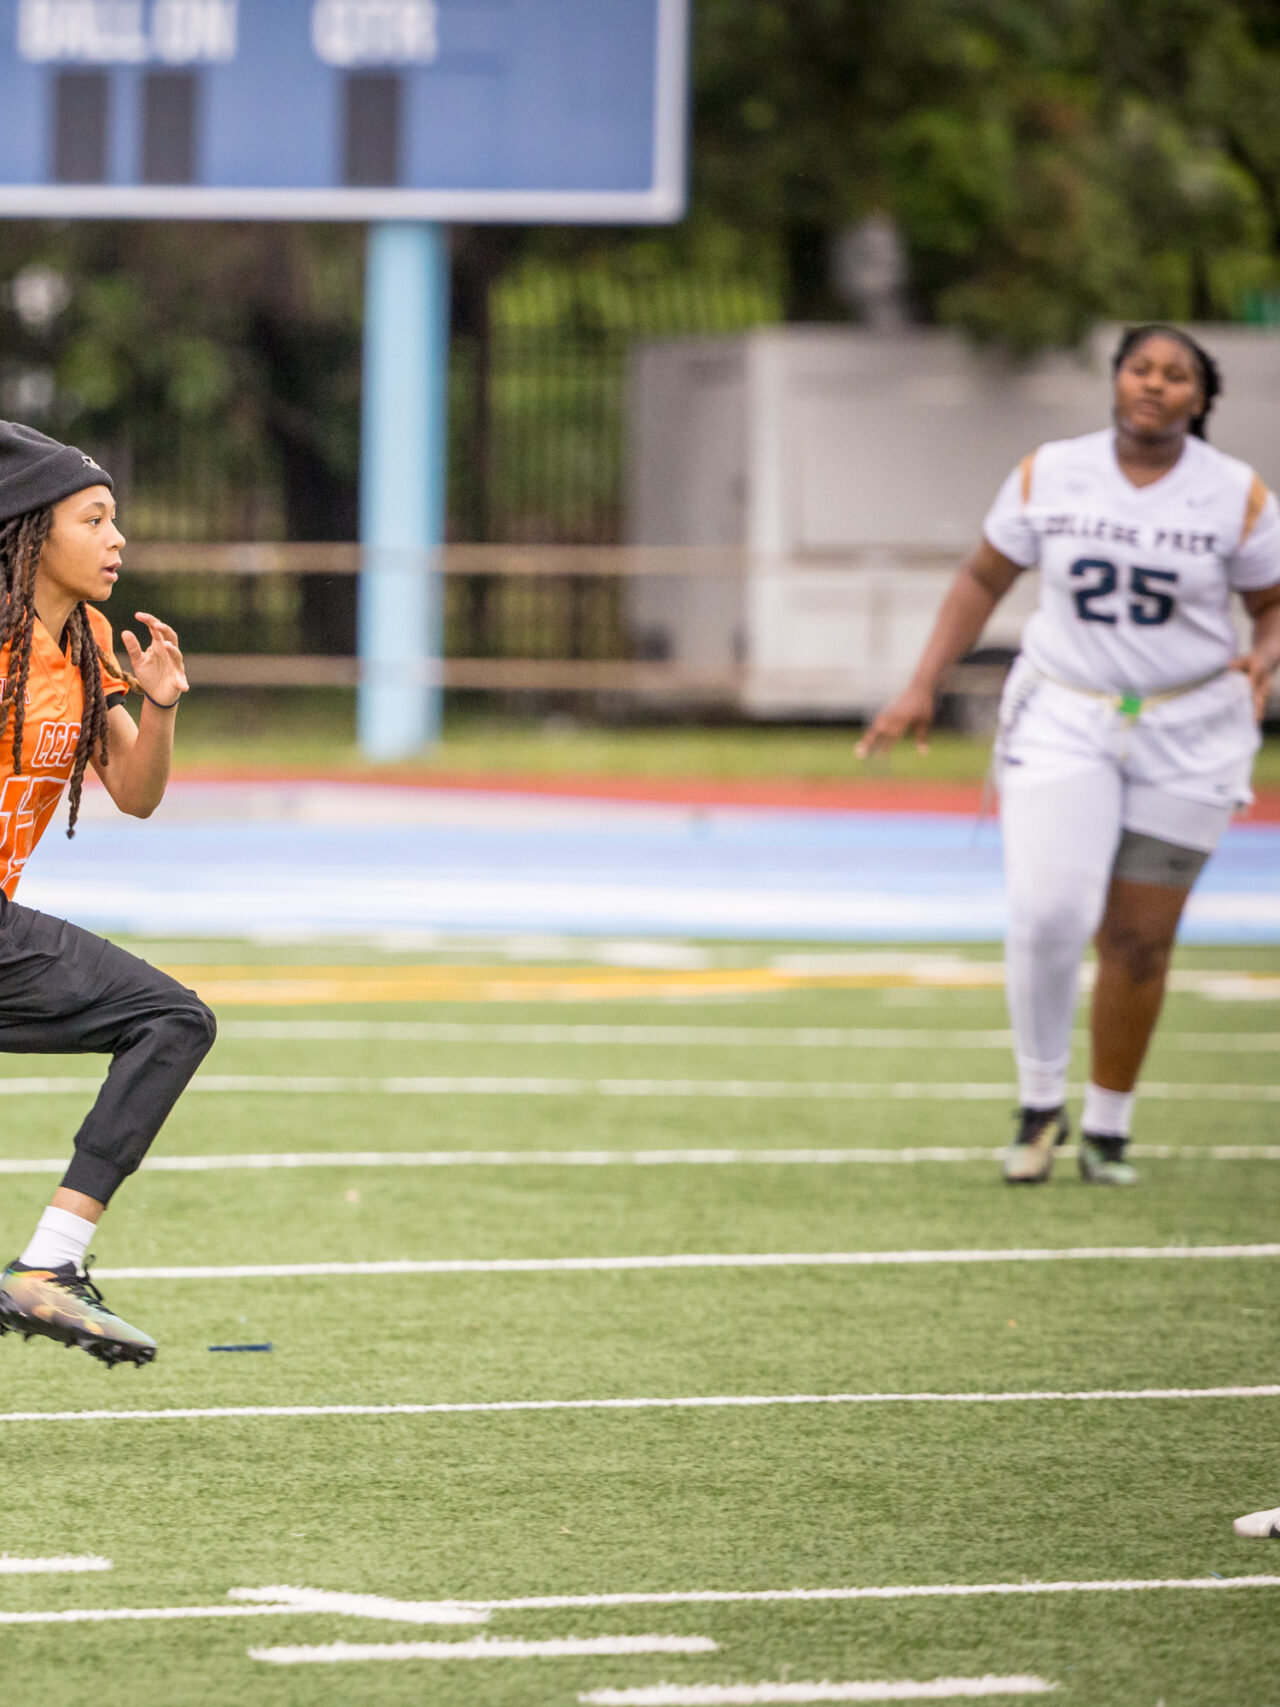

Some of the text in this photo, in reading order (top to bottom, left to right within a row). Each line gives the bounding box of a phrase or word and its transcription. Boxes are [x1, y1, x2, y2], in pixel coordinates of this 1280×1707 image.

[18, 0, 236, 62] BALL ON
[313, 0, 437, 65] QTR
[1070, 558, 1178, 626] 25
